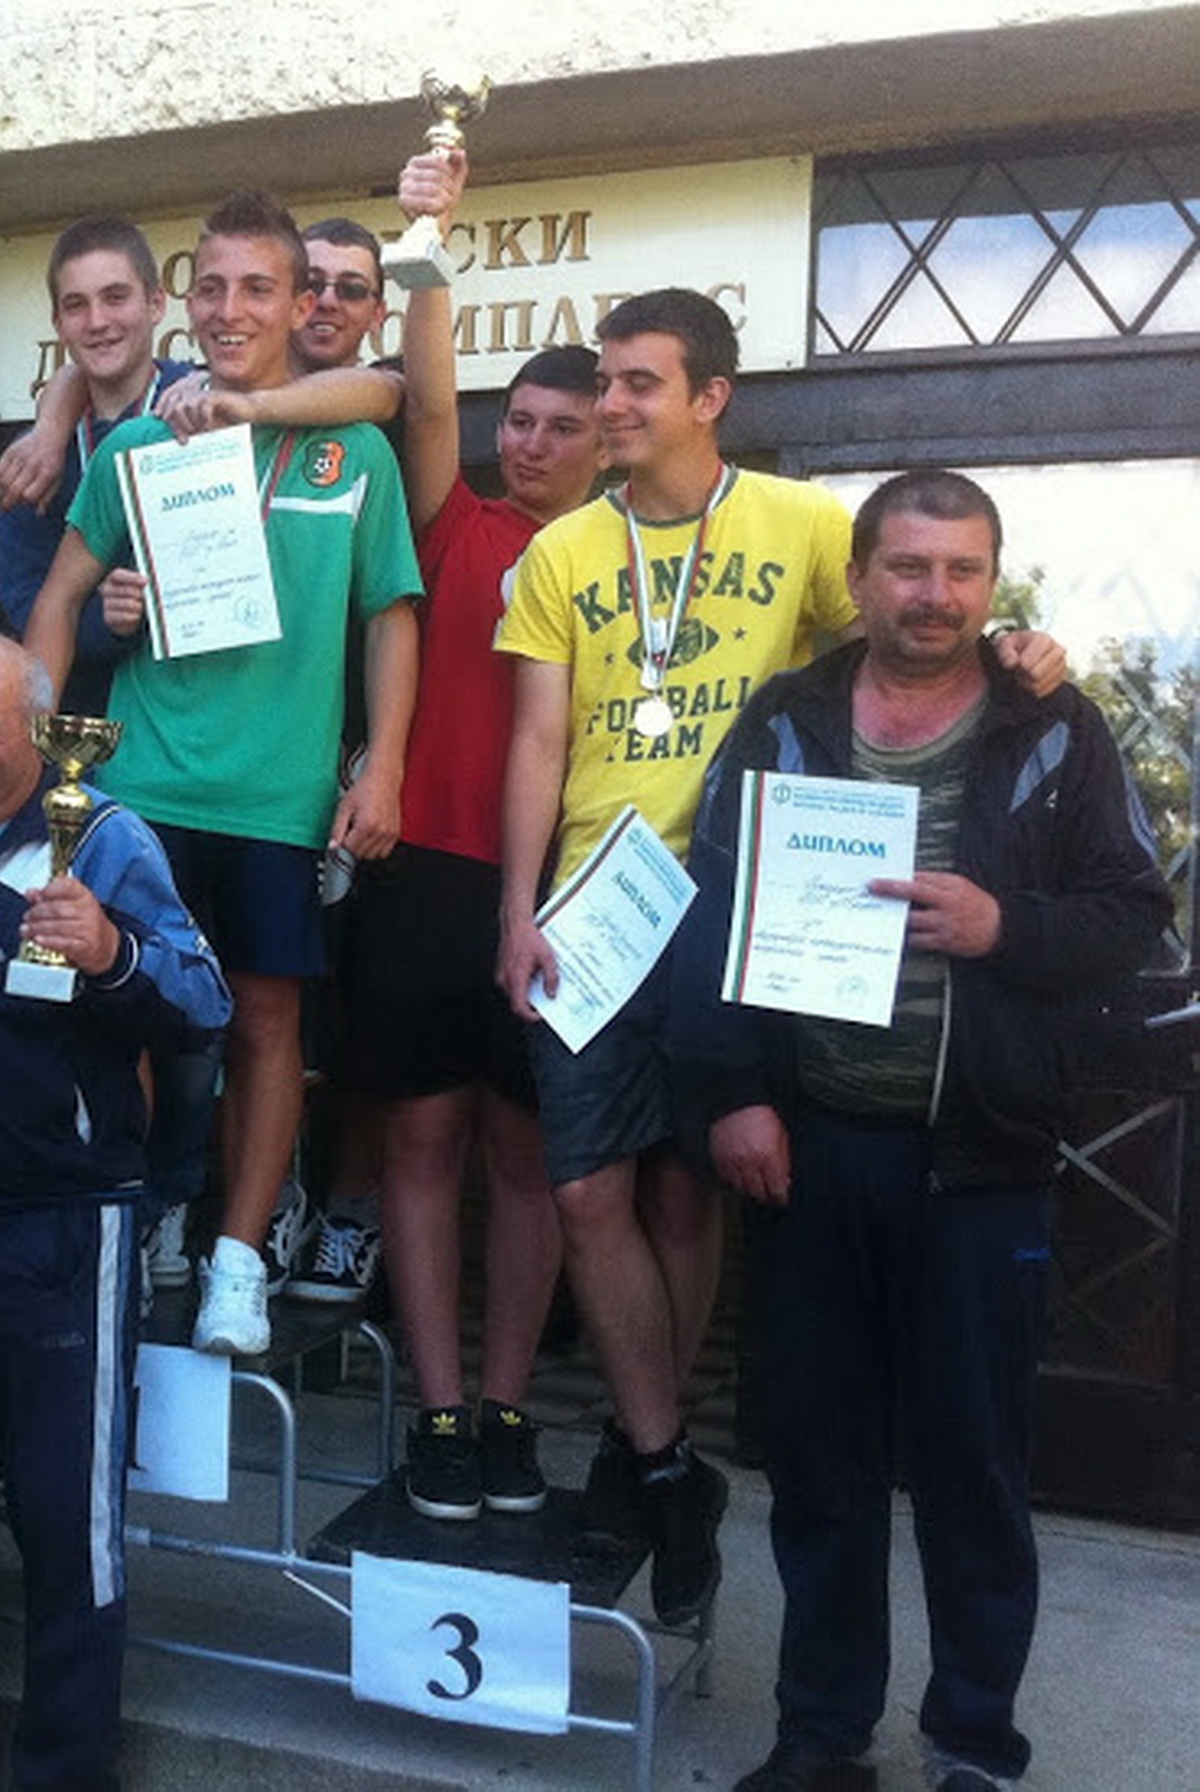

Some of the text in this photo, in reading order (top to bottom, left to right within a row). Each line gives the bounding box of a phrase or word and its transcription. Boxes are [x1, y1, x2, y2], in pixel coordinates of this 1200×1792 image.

[161, 482, 236, 512] ДИПЛОМ
[586, 676, 751, 735] FOBALL
[606, 722, 704, 763] EAM
[786, 832, 886, 859] ДИПЛОМ
[426, 1612, 483, 1701] 3
